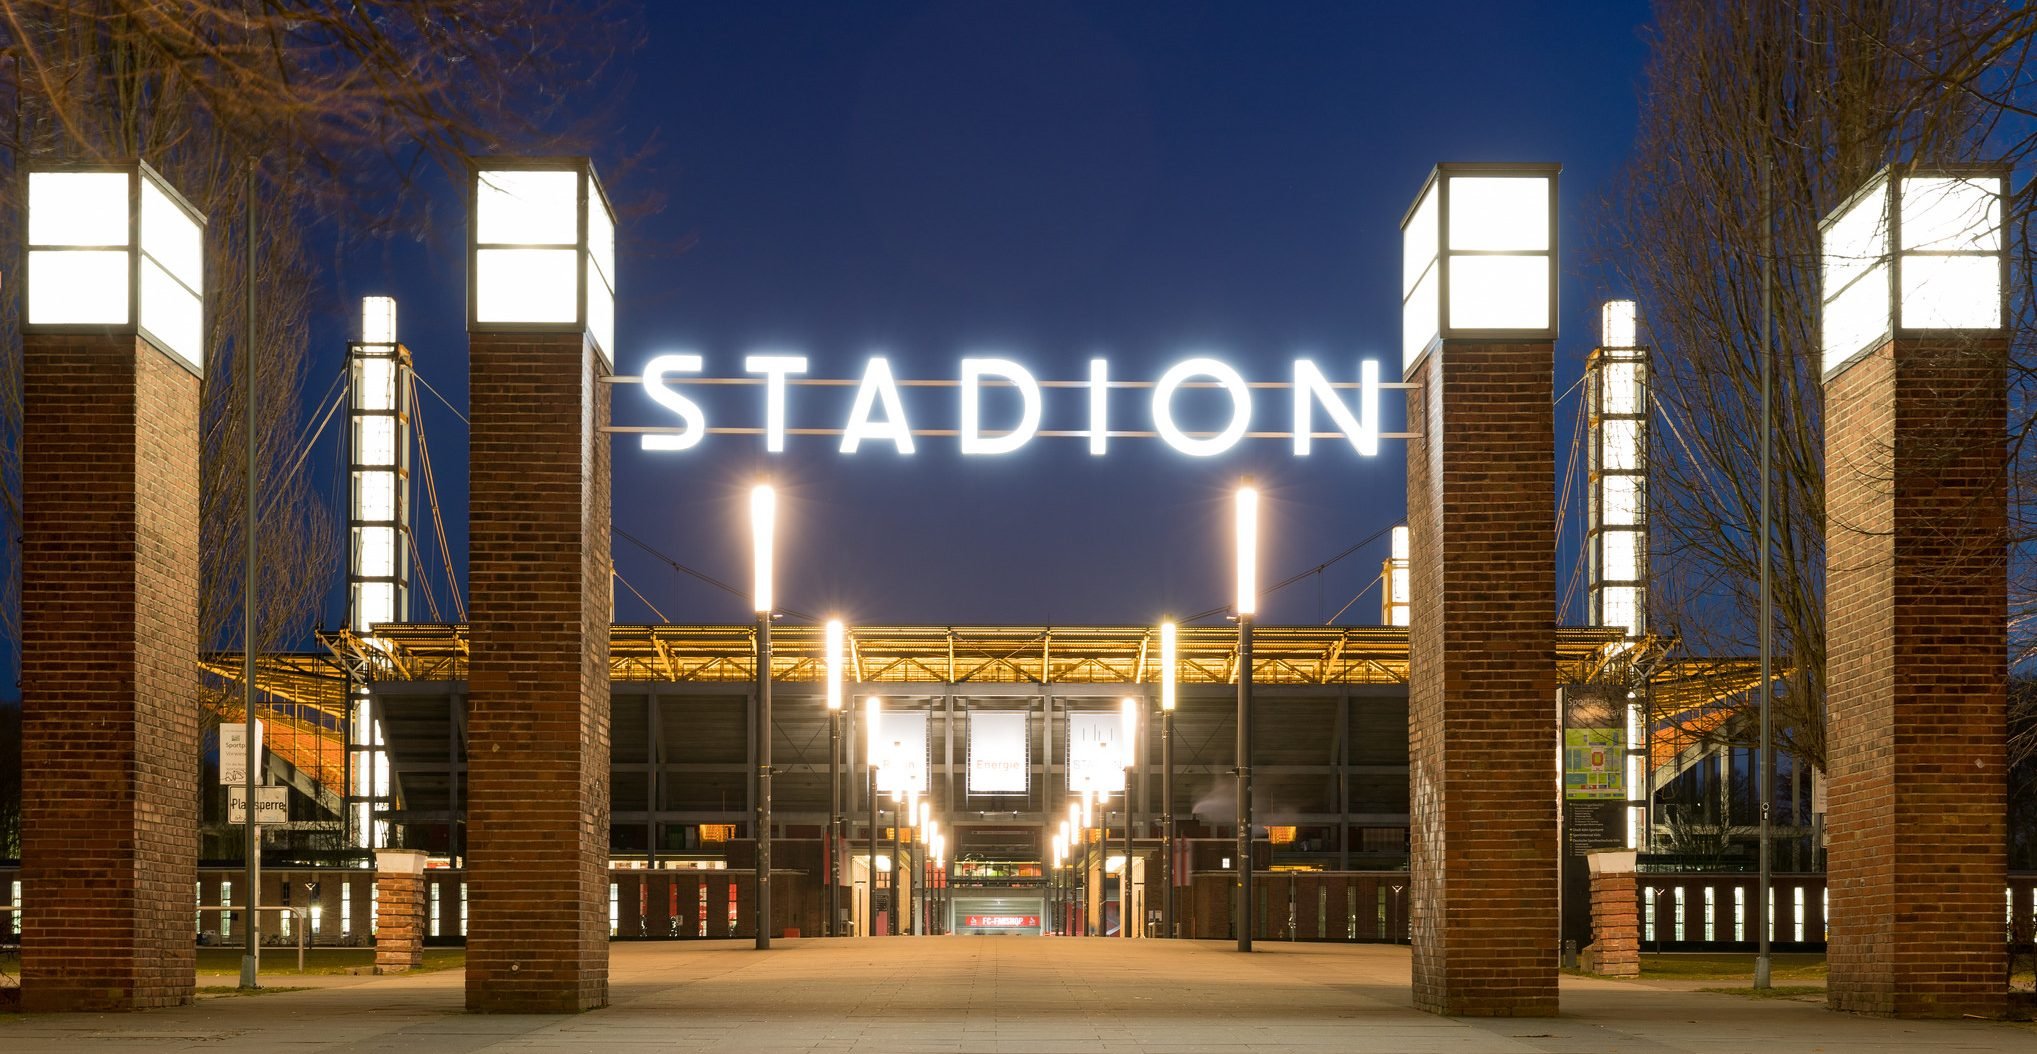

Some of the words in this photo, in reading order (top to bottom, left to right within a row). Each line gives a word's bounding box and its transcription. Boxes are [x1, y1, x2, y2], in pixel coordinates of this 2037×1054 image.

[640, 354, 1379, 457] STADION
[976, 759, 1020, 771] Energie
[231, 798, 284, 812] Plasperre
[982, 916, 1024, 926] FC-FHOP
